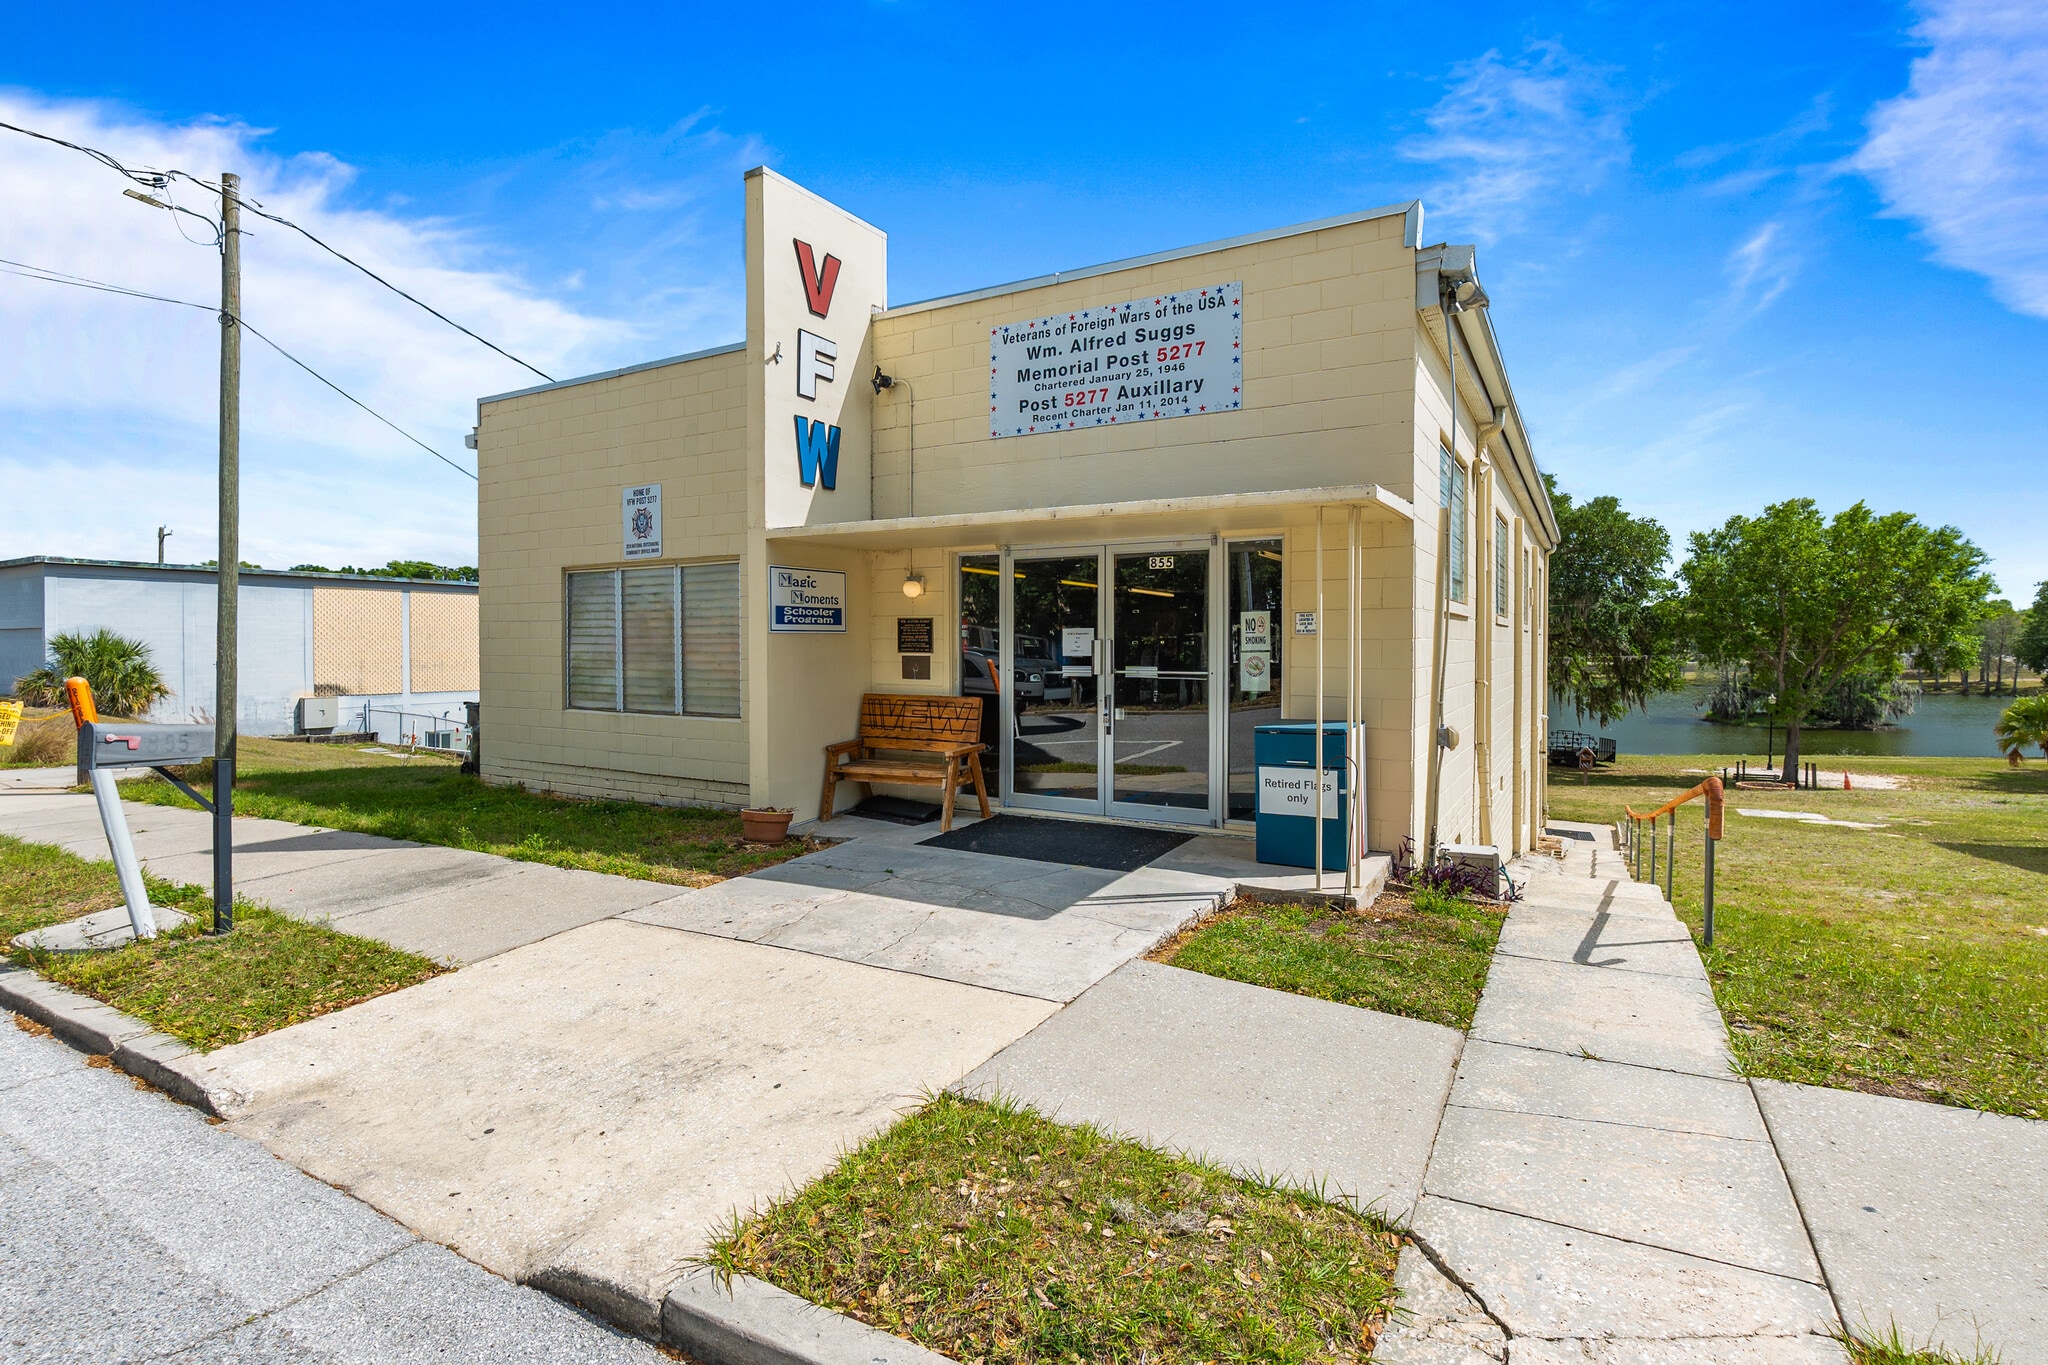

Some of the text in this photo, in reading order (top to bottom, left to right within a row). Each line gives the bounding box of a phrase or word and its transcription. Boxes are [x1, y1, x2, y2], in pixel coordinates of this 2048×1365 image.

[1002, 296, 1226, 345] Veterans of Foreign Wars of the USA
[1027, 323, 1196, 361] Wm. Alfred Suggs
[793, 238, 842, 490] VFW
[1017, 341, 1206, 383] Memorial Post 5277
[1034, 363, 1185, 392] Chartered January 25, 1946
[1019, 378, 1204, 413] Post 5277 Auxillary
[1032, 395, 1188, 423] Recent Charter Jan 11, 2014
[632, 487, 651, 497] HOME OF
[626, 495, 657, 506] VFW POST 5277
[1150, 557, 1173, 568] 855
[779, 572, 817, 588] Magic
[791, 590, 839, 605] Moments
[783, 606, 835, 616] Schooler
[784, 615, 834, 624] Program
[1245, 618, 1256, 631] NO
[1245, 636, 1266, 645] SMOKING
[1264, 778, 1301, 790] Retired
[1287, 794, 1309, 805] only
